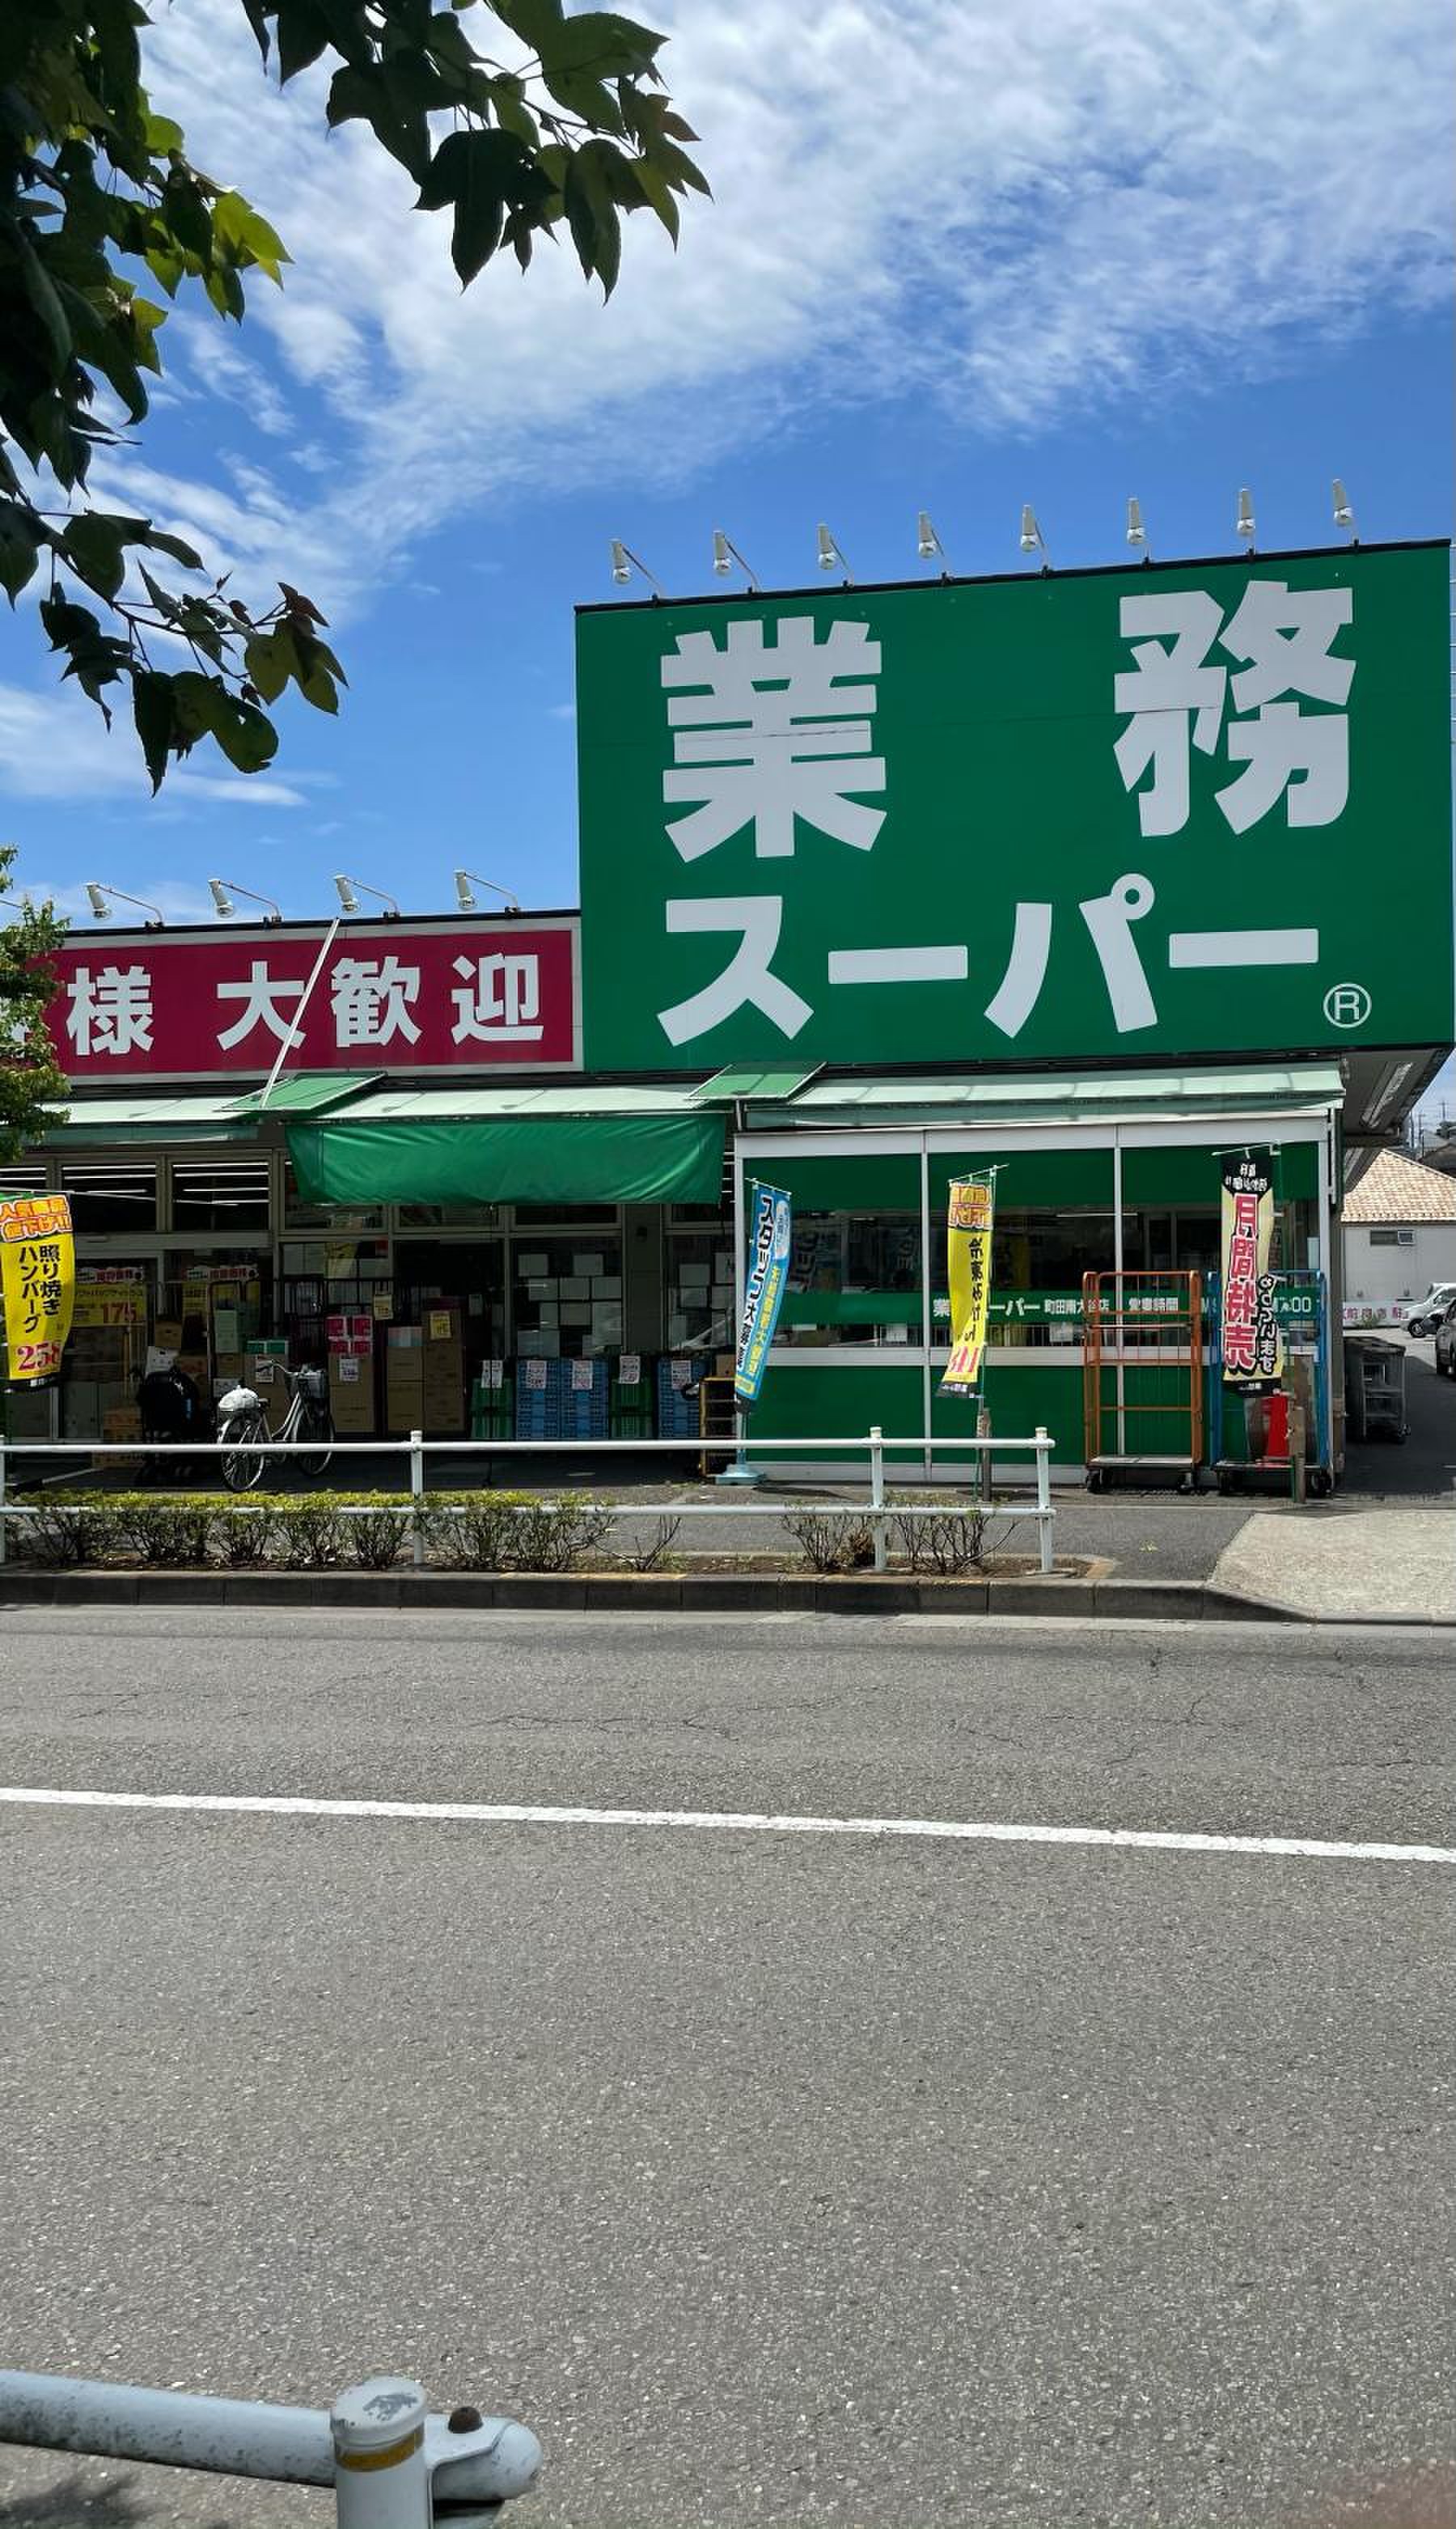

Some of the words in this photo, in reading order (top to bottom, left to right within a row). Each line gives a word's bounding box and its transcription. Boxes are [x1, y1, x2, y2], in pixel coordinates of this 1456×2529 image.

[661, 580, 1357, 862] 業務
[657, 873, 1318, 1046] スーパー
[19, 1246, 41, 1334] ハンバーグ
[39, 1244, 61, 1316] 照り焼き
